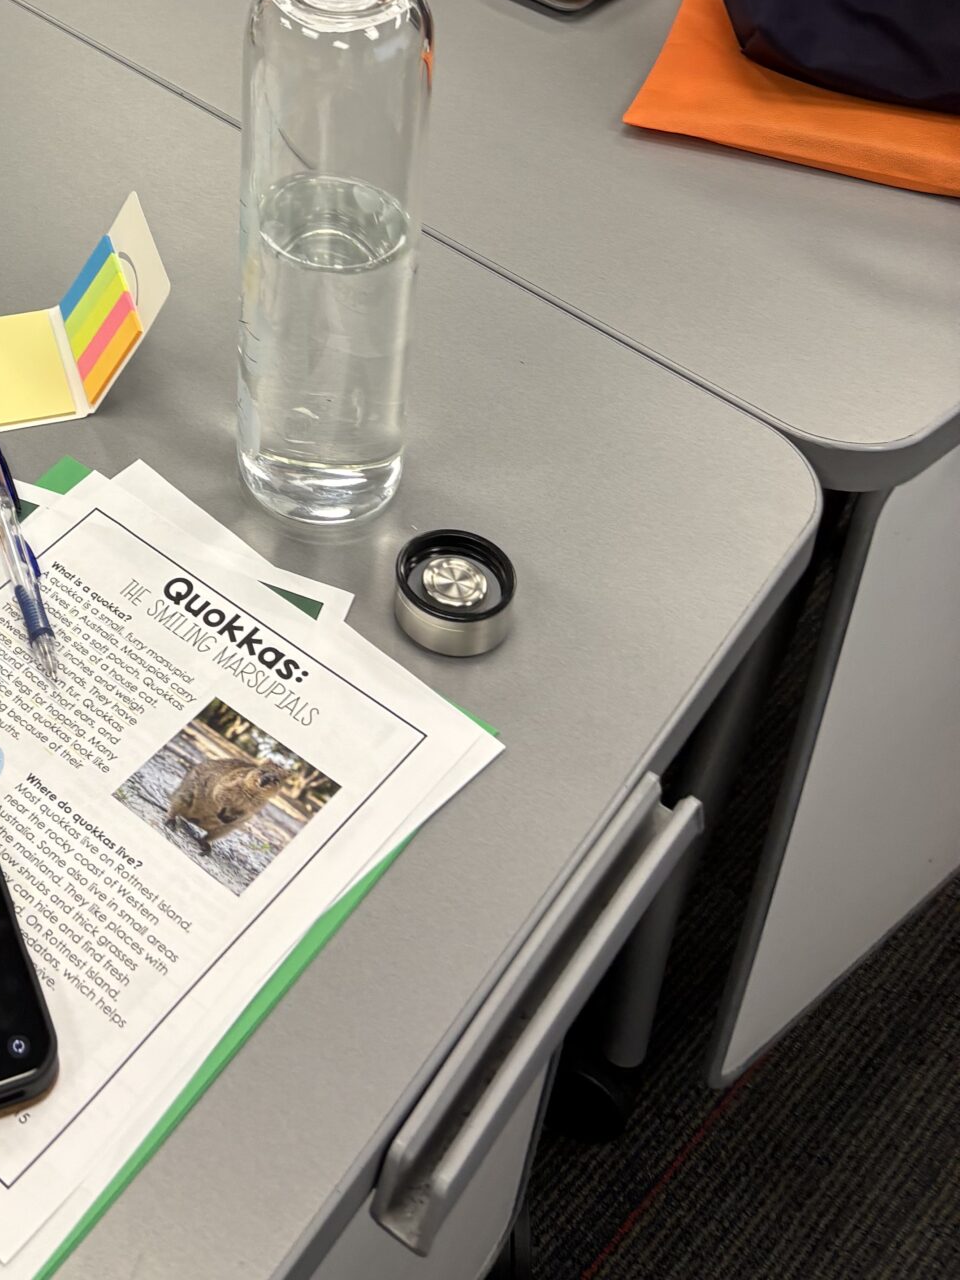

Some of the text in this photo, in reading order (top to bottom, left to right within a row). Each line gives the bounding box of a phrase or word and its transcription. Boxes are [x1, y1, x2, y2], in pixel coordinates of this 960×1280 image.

[49, 577, 194, 683] quokka is a small, furry marsupial
[51, 561, 131, 621] What is a quokka?
[163, 577, 309, 683] Quokkas:
[119, 578, 320, 727] THE SMILING MARSUPIALS
[3, 794, 158, 925] near the rocky coast of Western
[14, 782, 41, 804] Most
[39, 804, 80, 839] quokkas
[79, 835, 99, 854] live
[99, 853, 114, 867] on
[114, 863, 158, 902] Rottnest
[26, 772, 142, 869] Where do quokkas live?
